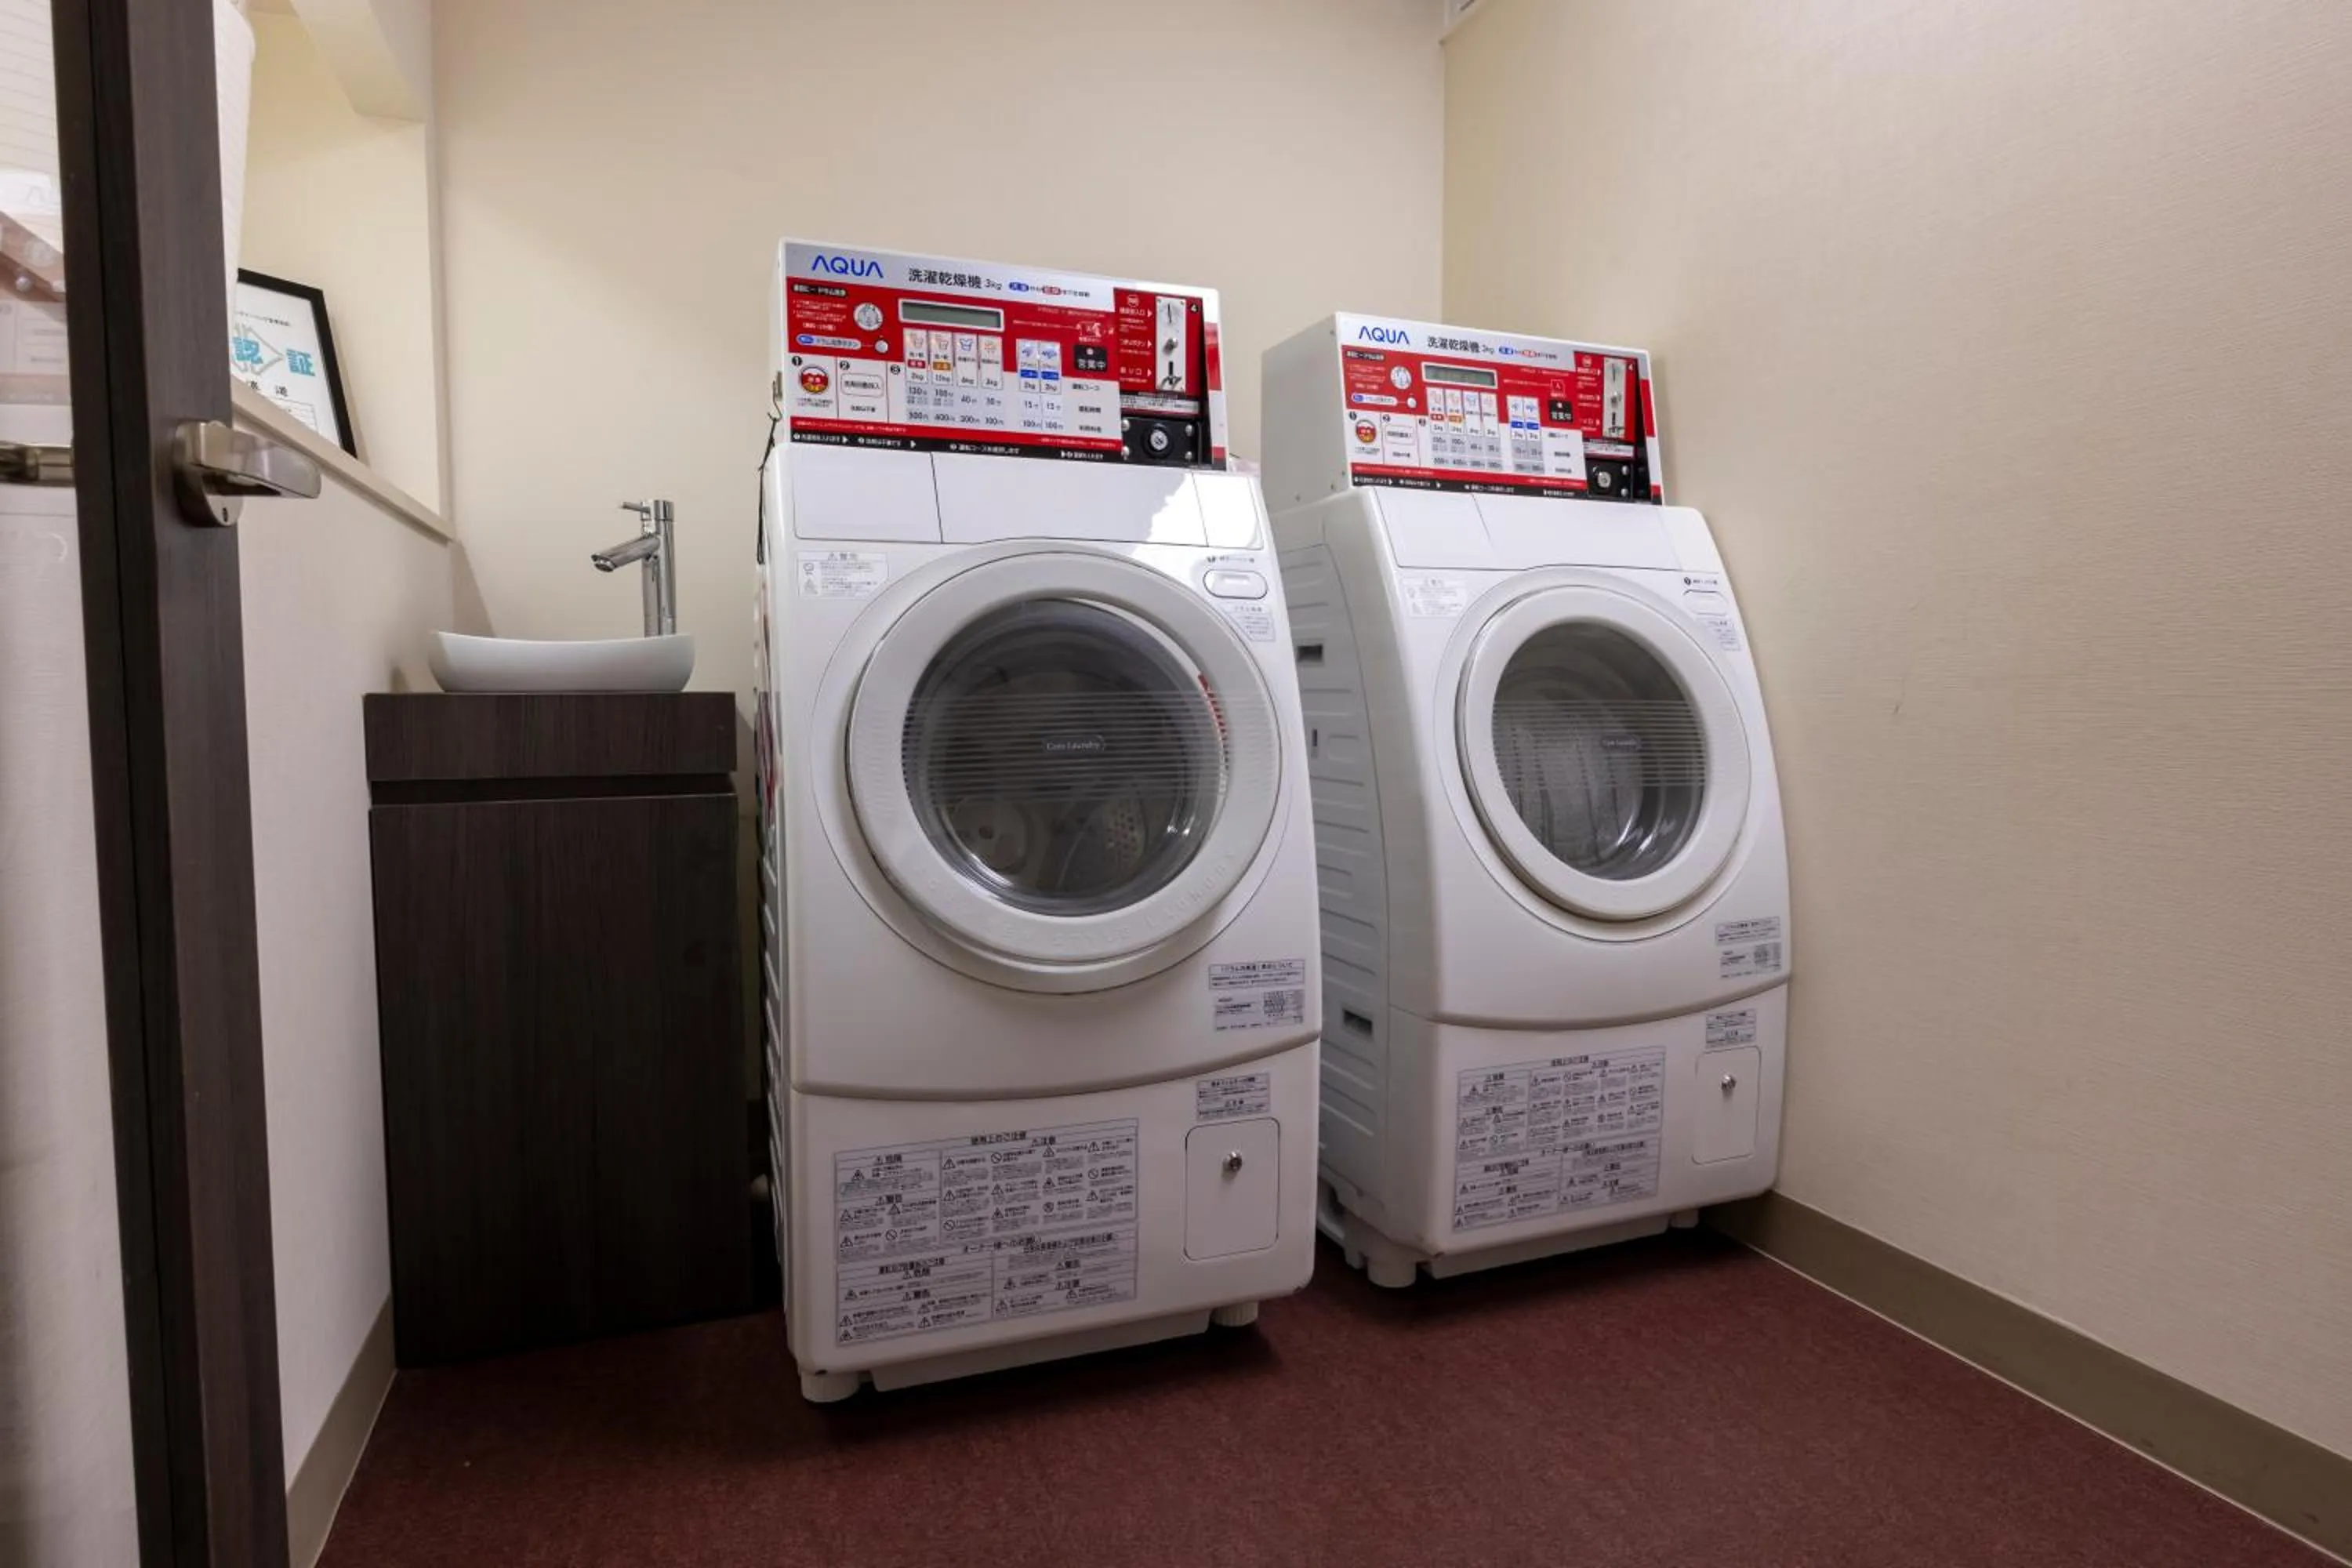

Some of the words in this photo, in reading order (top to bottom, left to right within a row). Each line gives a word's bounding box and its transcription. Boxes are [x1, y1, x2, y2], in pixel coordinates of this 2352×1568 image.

[811, 255, 884, 278] AQUA
[909, 267, 982, 289] 洗濯乾燥機
[985, 278, 1003, 291] 3kg
[1359, 326, 1409, 344] AQUA
[1427, 336, 1479, 353] 洗濯乾燥機
[1078, 358, 1106, 370] 営業中
